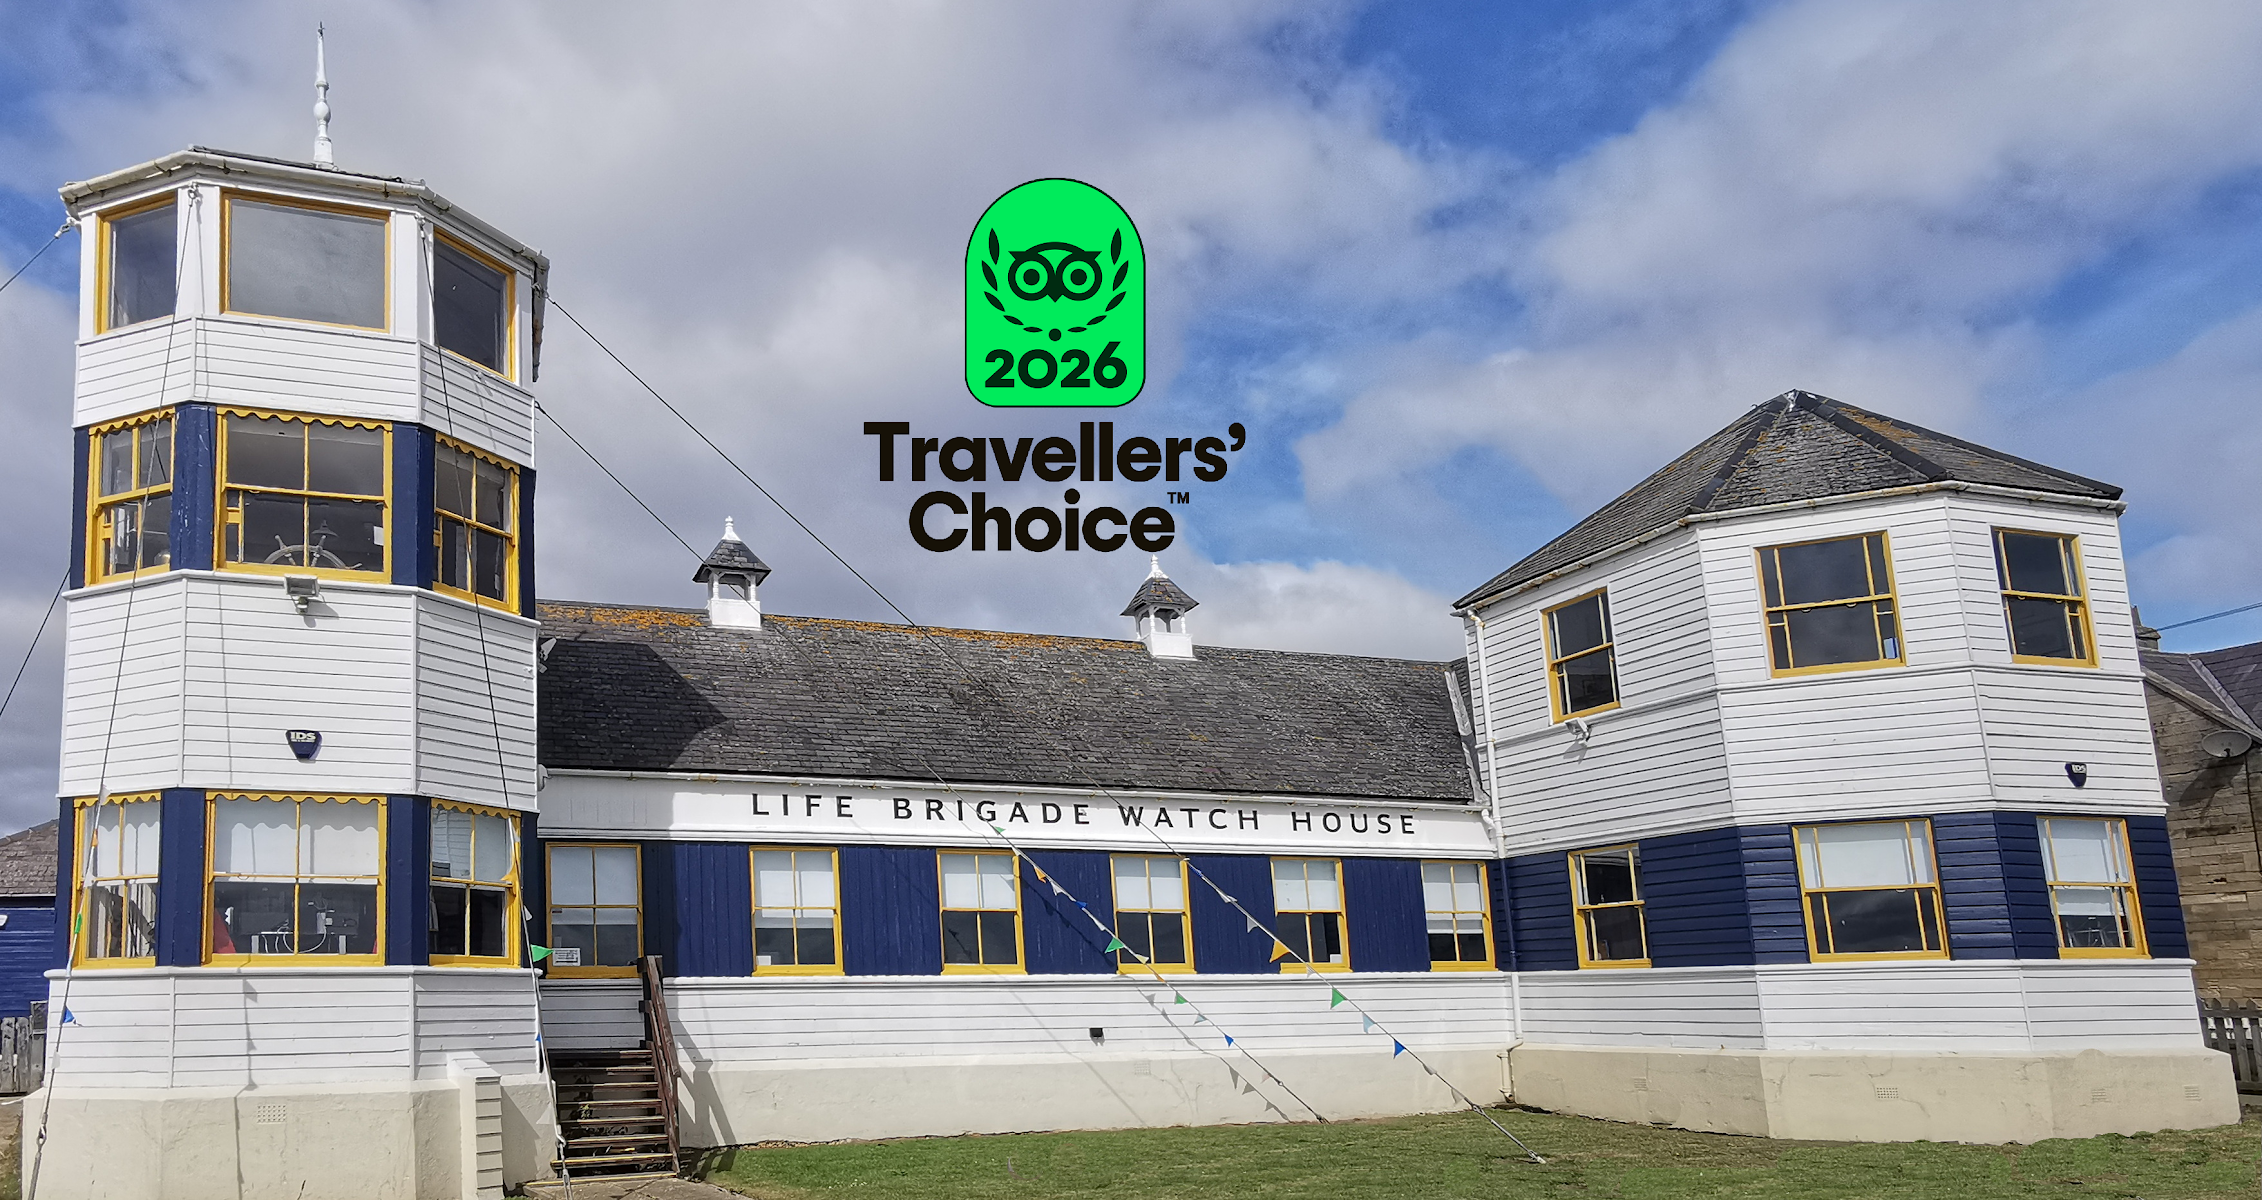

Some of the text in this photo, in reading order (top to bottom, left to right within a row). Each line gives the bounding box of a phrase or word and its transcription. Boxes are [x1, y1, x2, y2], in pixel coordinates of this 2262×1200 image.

[290, 731, 316, 740] IDS
[751, 793, 1415, 835] LIFE BRIGADE WATCH HOUSE
